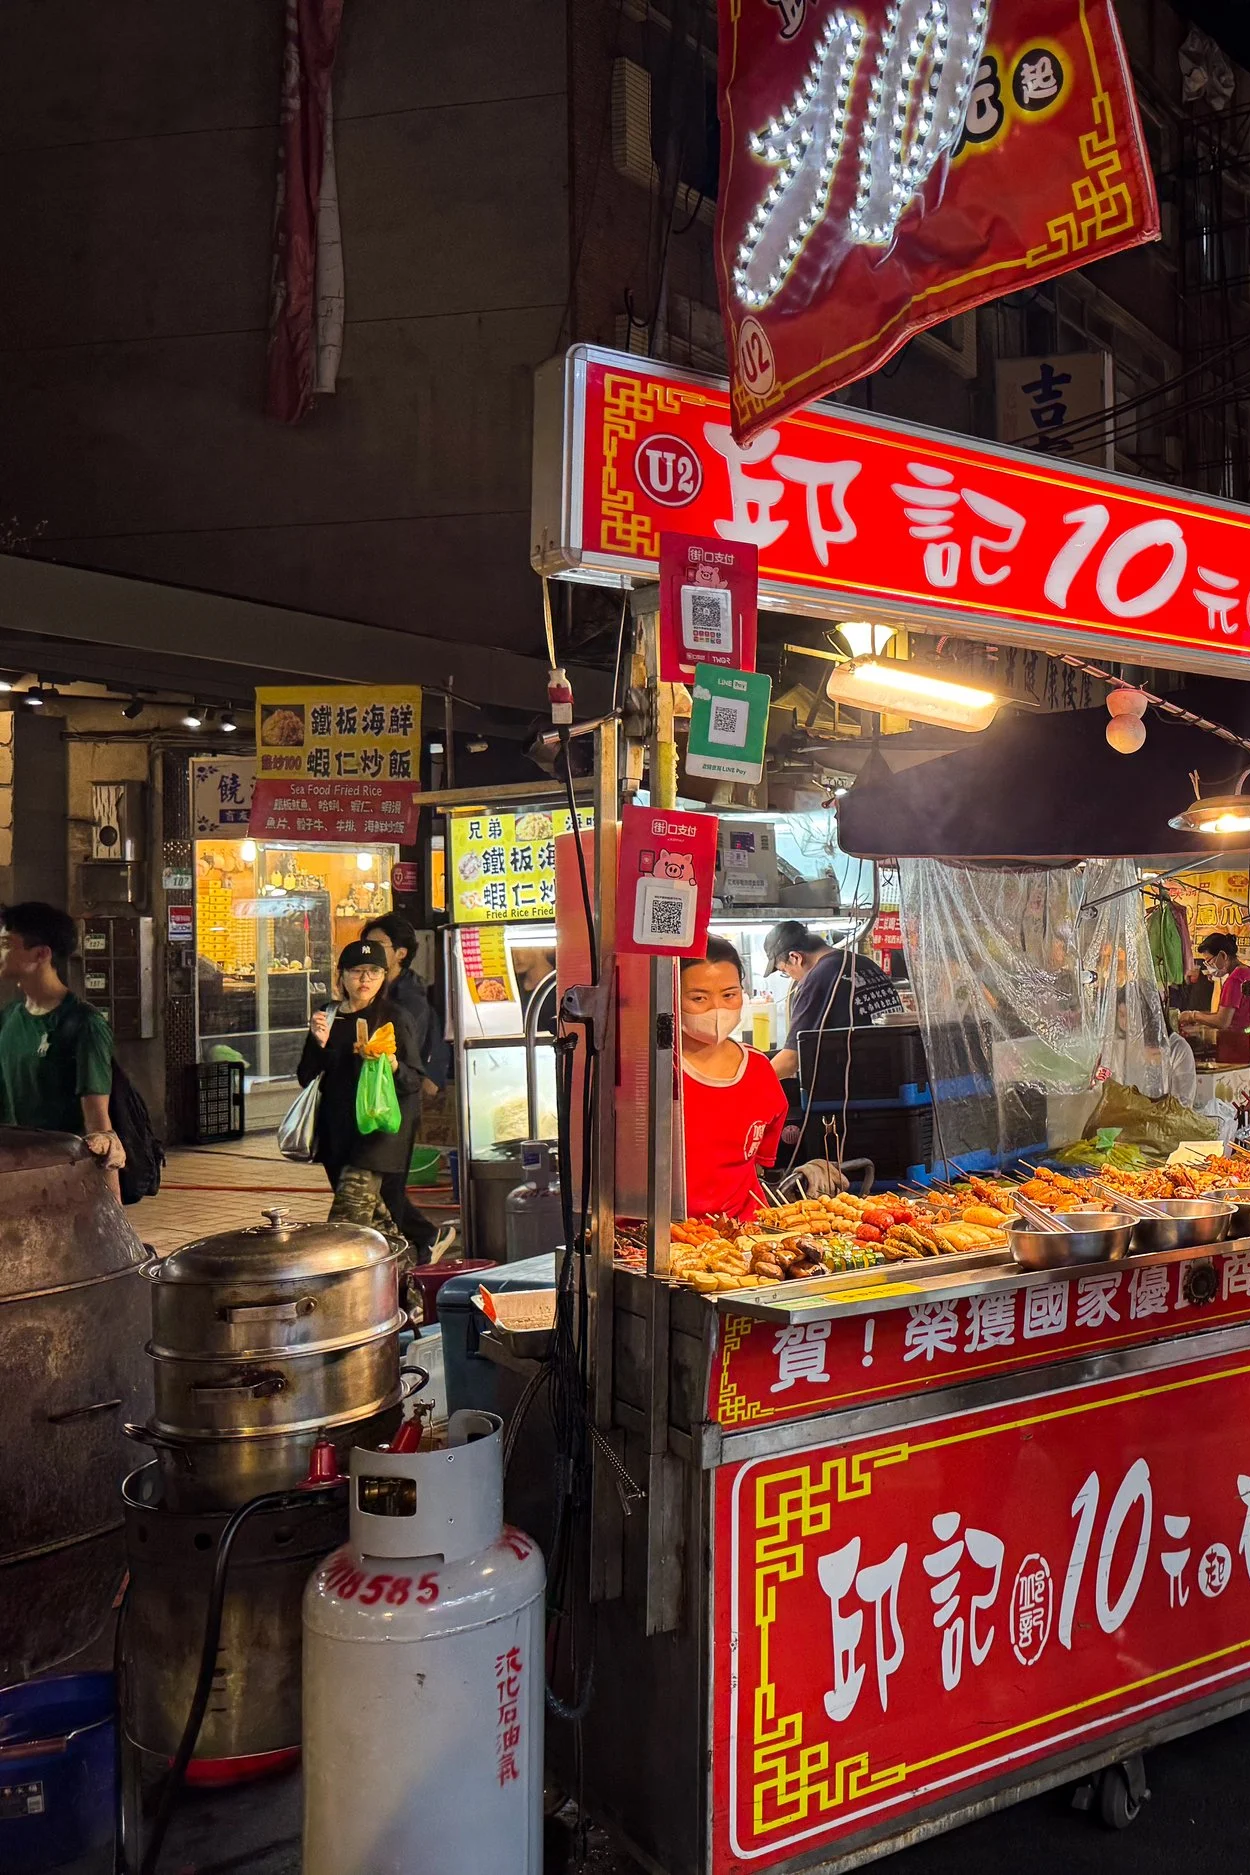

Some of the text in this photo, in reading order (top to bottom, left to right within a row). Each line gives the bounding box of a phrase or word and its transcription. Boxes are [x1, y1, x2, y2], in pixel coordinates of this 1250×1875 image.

[742, 338, 770, 383] U2
[645, 449, 695, 494] U2
[718, 679, 732, 687] LINE
[311, 704, 413, 736] 鐵板海鮮
[307, 748, 412, 778] 蝦仁炒飯
[290, 784, 383, 796] Sea Food Fried Rice
[468, 819, 502, 840] 兄弟
[652, 818, 697, 837] 街口支付
[486, 907, 554, 919] Fried Rice Fried
[817, 1511, 1004, 1722] 邱記
